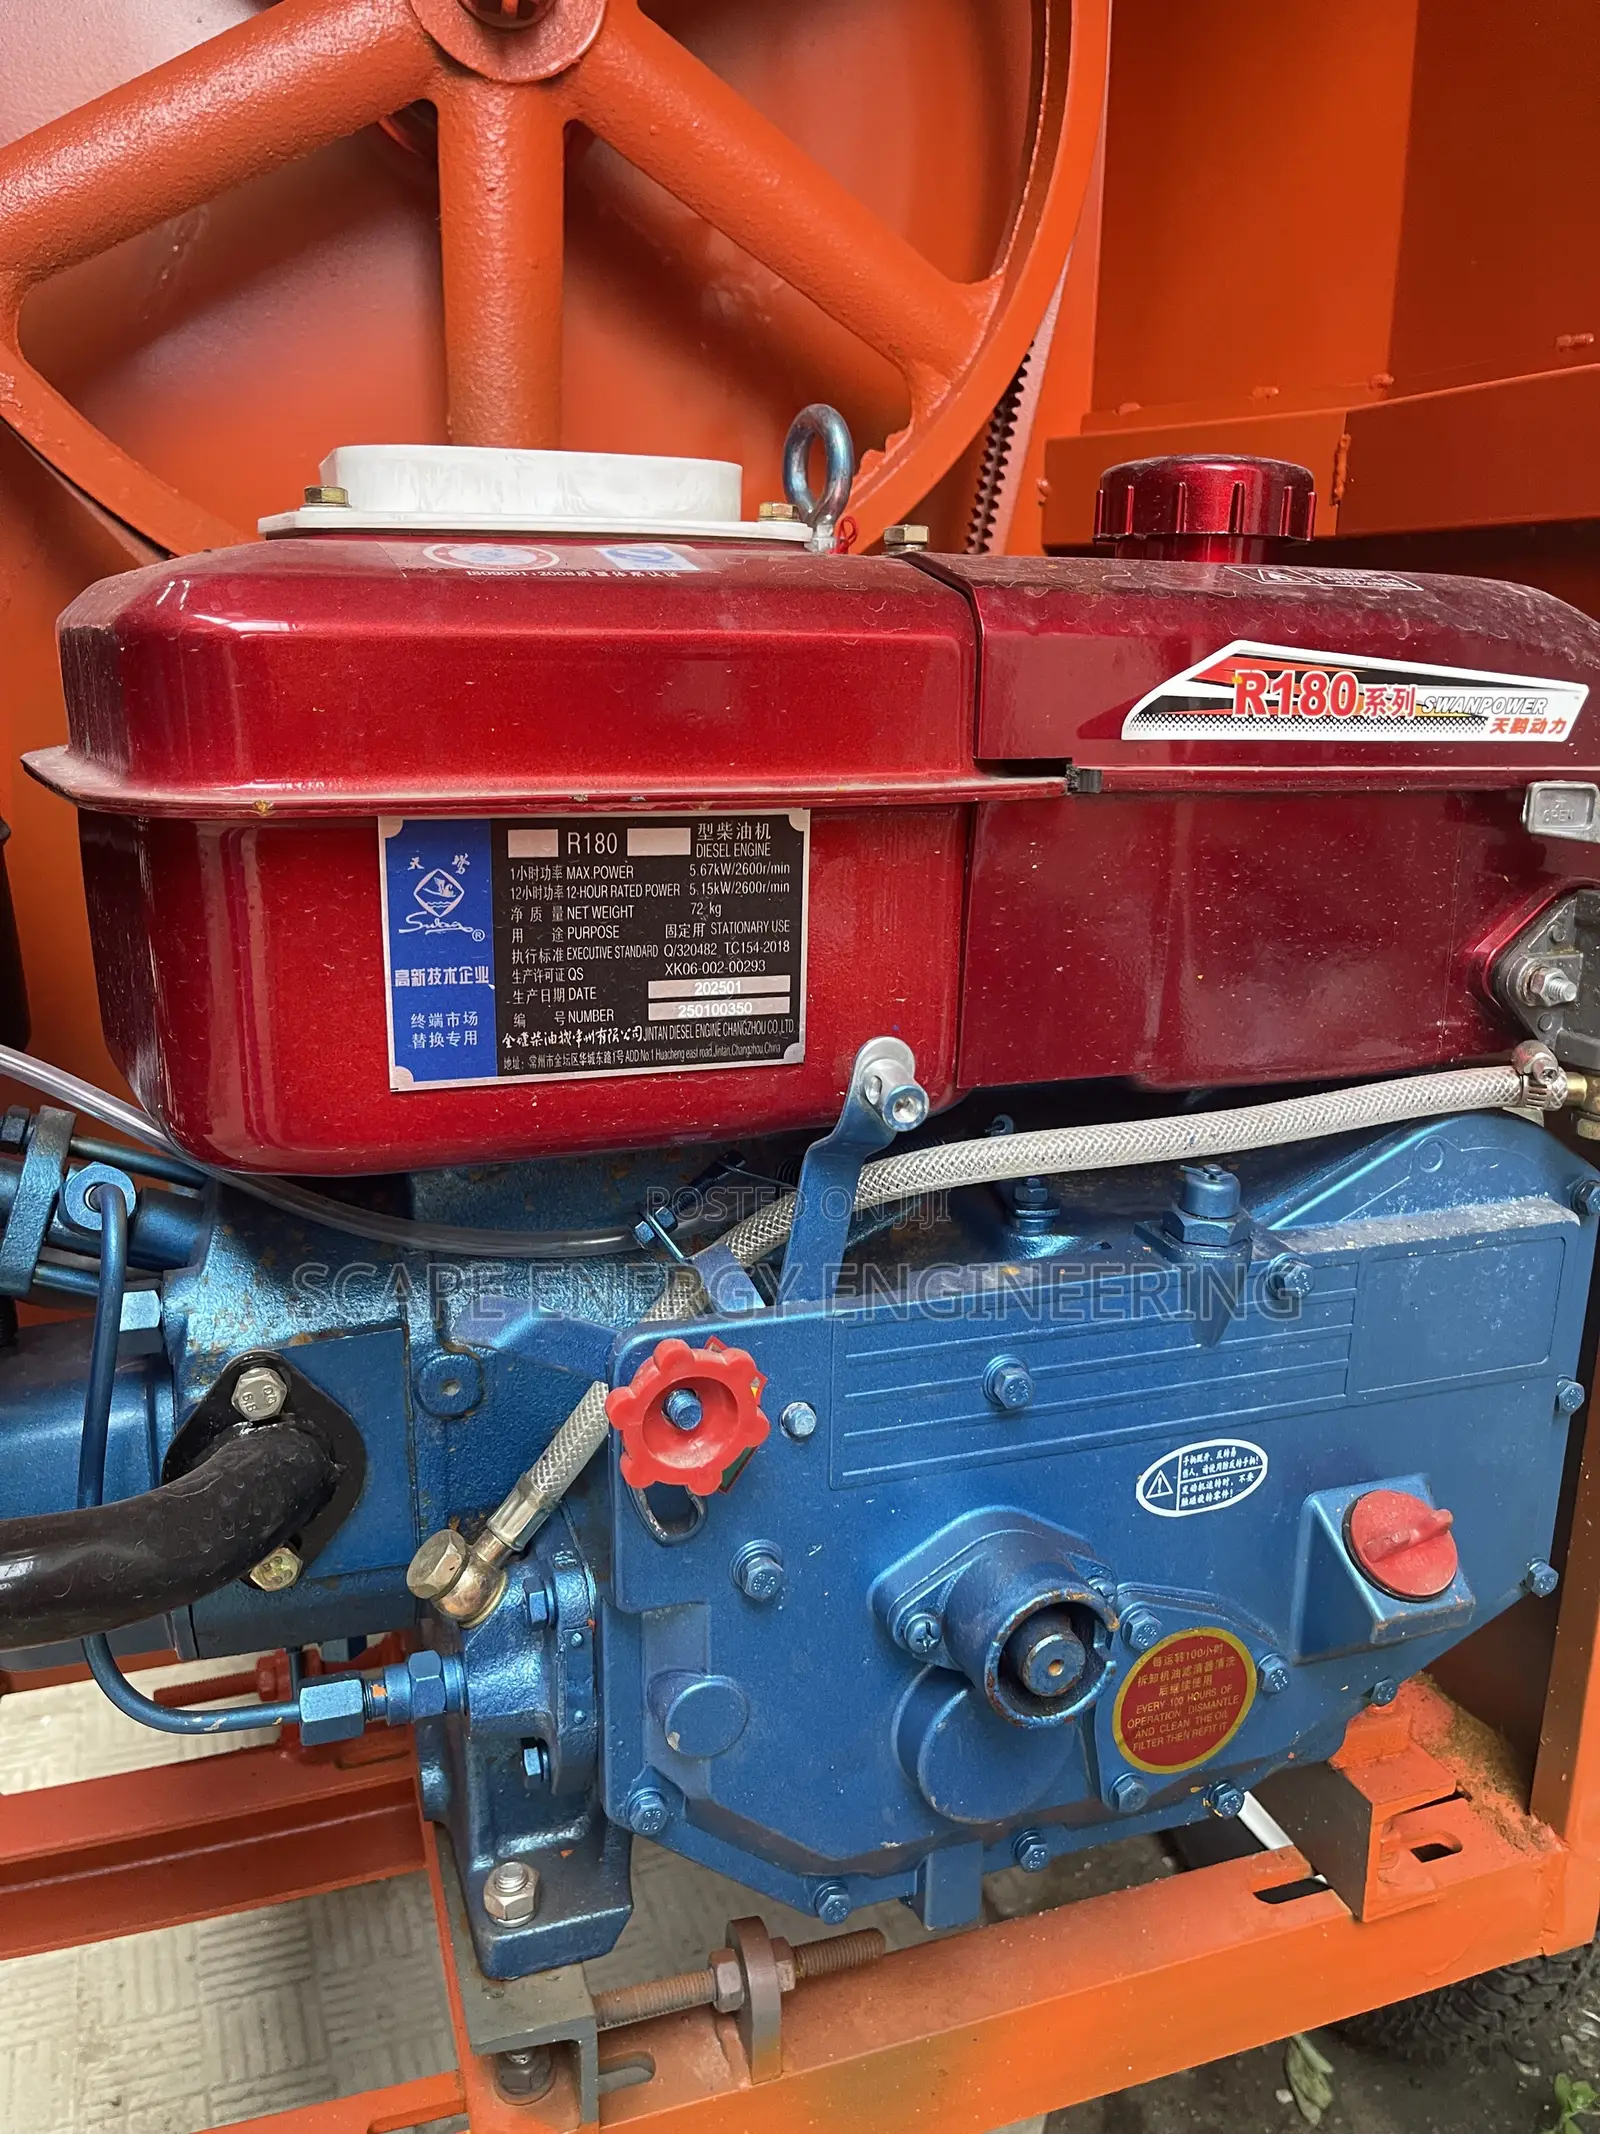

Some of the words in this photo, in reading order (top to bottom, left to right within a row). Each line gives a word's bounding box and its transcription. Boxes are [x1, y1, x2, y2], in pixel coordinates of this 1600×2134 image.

[1233, 670, 1358, 718] R180
[1422, 696, 1548, 715] SWANPOWER
[1489, 717, 1567, 734] 天鹅动力
[697, 822, 771, 840] 型柴油机
[568, 832, 617, 854] R180
[696, 843, 731, 858] DIESEL
[734, 842, 771, 857] ENGINE
[510, 865, 563, 881] 1小时功率
[566, 865, 634, 880] MAX.POWER
[689, 862, 790, 876] 5.67kW/2600r/min
[510, 883, 564, 900] 12小时功率
[566, 885, 608, 899] 12-HOUR
[611, 884, 643, 898] RATED
[645, 883, 681, 897] POWER
[689, 881, 790, 896] 5.15kW/2600r/min
[567, 906, 589, 920] NET
[591, 904, 635, 919] WEIGHT
[691, 902, 704, 915] 72
[709, 902, 722, 917] kg
[567, 925, 620, 940] PURPOSE
[665, 923, 706, 939] 固定用
[711, 921, 770, 935] STATIONARY
[771, 920, 790, 933] USE
[512, 948, 565, 964] 执行标准
[567, 945, 612, 960] EXECUTIVE
[614, 944, 659, 959] STANDARD
[664, 943, 717, 957] Q/320482
[724, 940, 790, 955] TC154-2018
[394, 966, 489, 987] 高新技术企业
[512, 968, 565, 984] 生产许可证
[568, 967, 584, 981] QS
[665, 960, 766, 976] XK06-002-00293
[513, 987, 565, 1005] 生产日期
[568, 987, 597, 1000] DATE
[694, 980, 741, 995] 202501
[411, 1010, 478, 1029] 终端市场
[568, 1009, 614, 1023] NUMBER
[678, 1002, 753, 1018] 250100350
[412, 1030, 477, 1049] 替换专用
[644, 1025, 668, 1041] JINTAN
[669, 1024, 694, 1040] DIESEL
[696, 1022, 721, 1038] ENGINE
[723, 1020, 766, 1036] CHANGZHOU
[686, 1046, 699, 1058] east
[1136, 1700, 1165, 1714] EVERY
[1170, 1696, 1184, 1706] 100
[1187, 1688, 1217, 1702] HOURS
[1220, 1684, 1233, 1695] OF
[1127, 1710, 1181, 1729] OPERATION
[1188, 1695, 1240, 1715] DISMANTLE
[1134, 1726, 1155, 1739] AND
[1160, 1719, 1190, 1733] CLEAN
[1195, 1713, 1213, 1725] THE
[1214, 1710, 1228, 1720] OIL
[1132, 1736, 1165, 1752] FILTER
[1166, 1730, 1190, 1744] THEN
